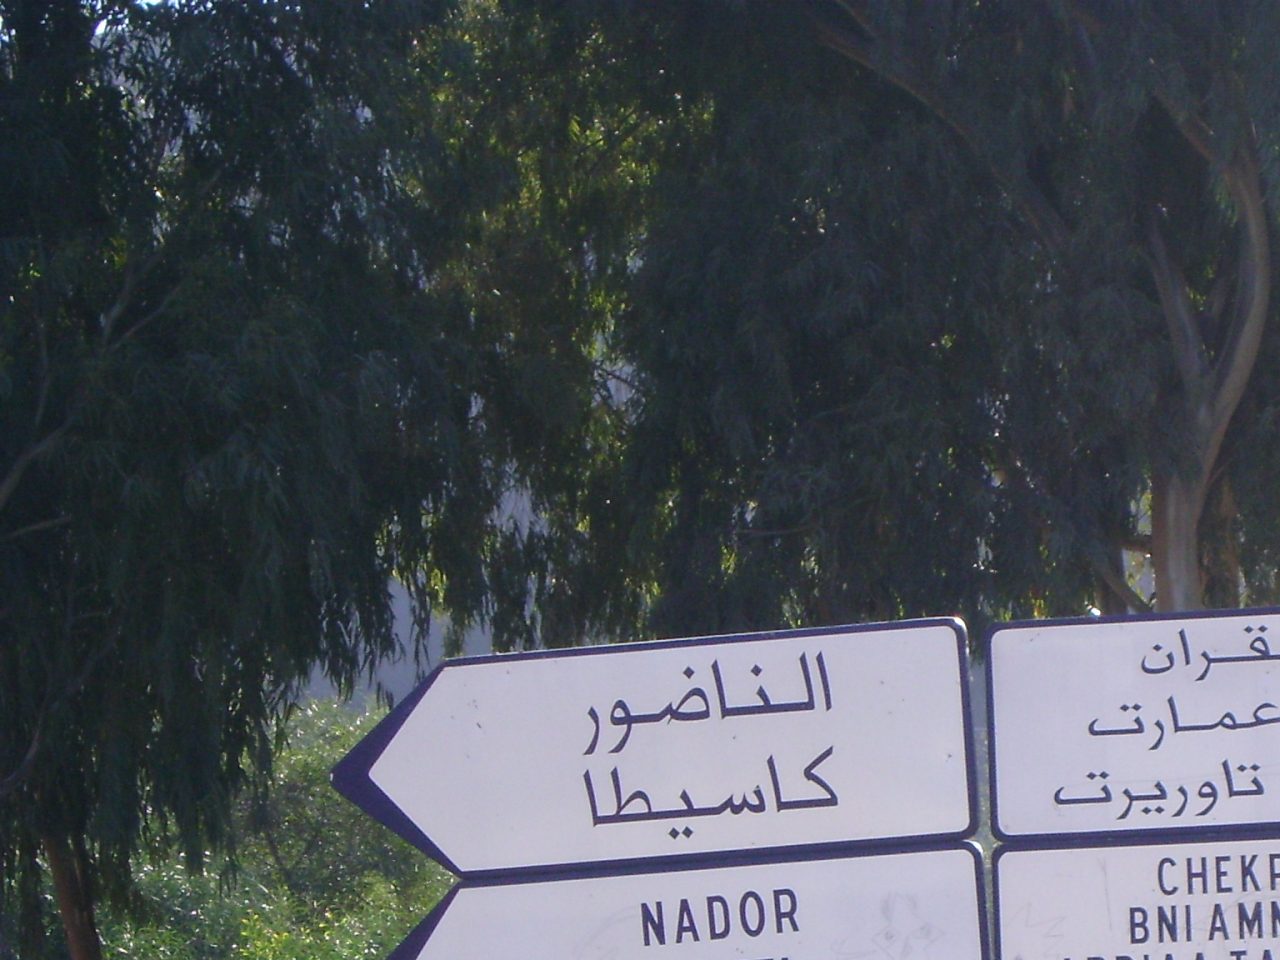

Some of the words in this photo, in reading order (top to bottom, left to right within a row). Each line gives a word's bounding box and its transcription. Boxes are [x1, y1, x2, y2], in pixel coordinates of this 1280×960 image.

[583, 651, 832, 755] الناضور
[583, 746, 838, 840] كاسيطا
[1054, 759, 1264, 820] تاوريرت
[641, 889, 799, 946] NADOR
[1130, 905, 1192, 944] BNI
